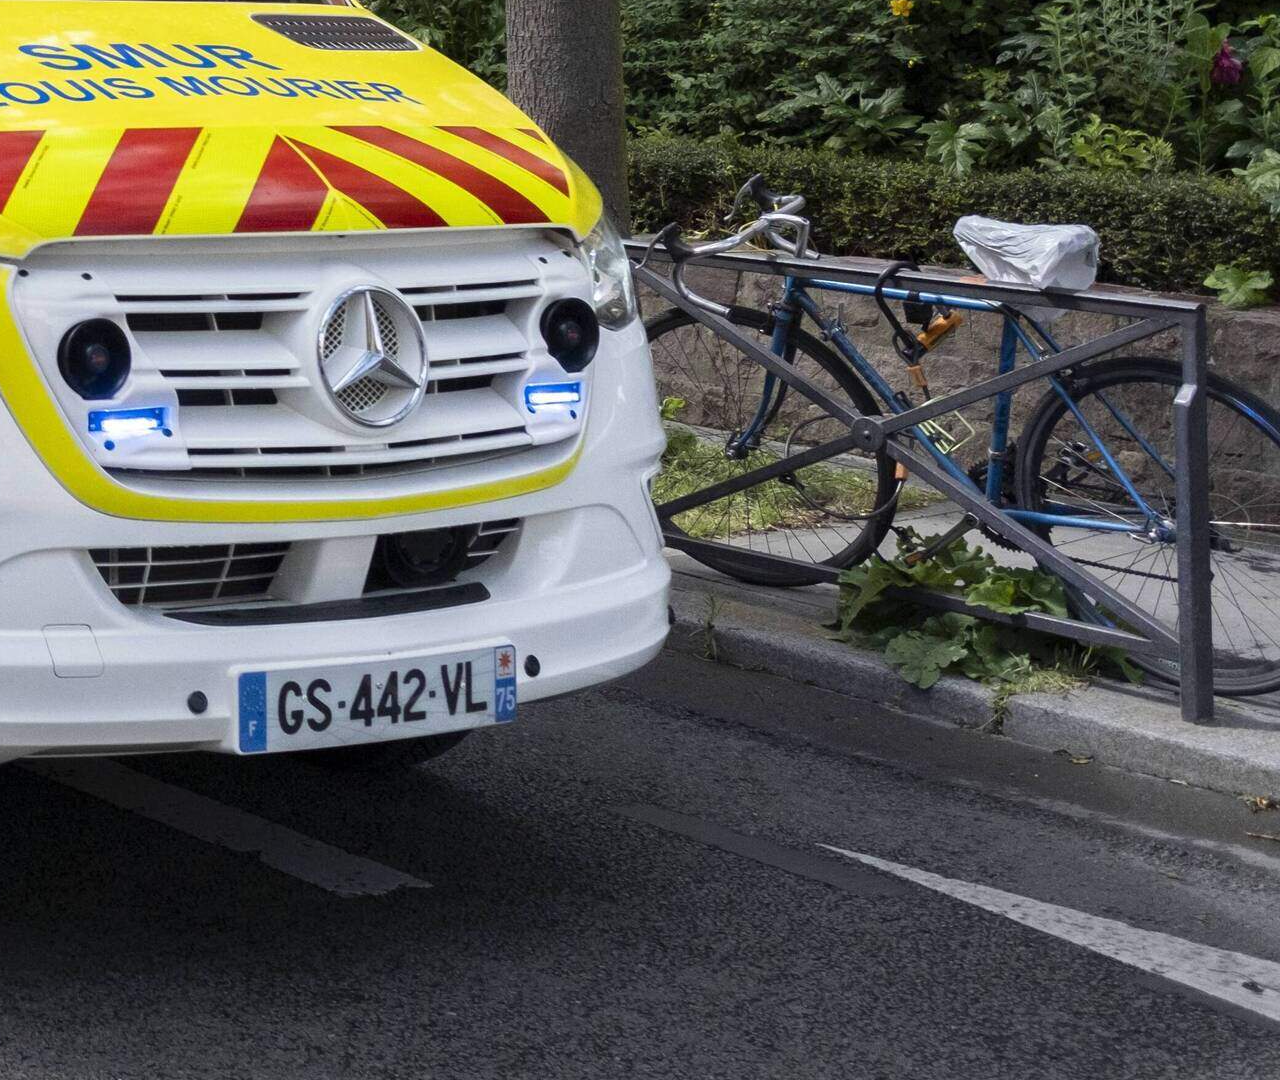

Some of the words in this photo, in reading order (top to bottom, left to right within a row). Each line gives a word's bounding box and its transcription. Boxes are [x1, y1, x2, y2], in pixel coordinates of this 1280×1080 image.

[18, 43, 284, 72] SMUR
[157, 75, 423, 106] MOURIER
[278, 660, 488, 736] GS-442-VL
[496, 686, 515, 713] 75
[248, 720, 258, 737] F
